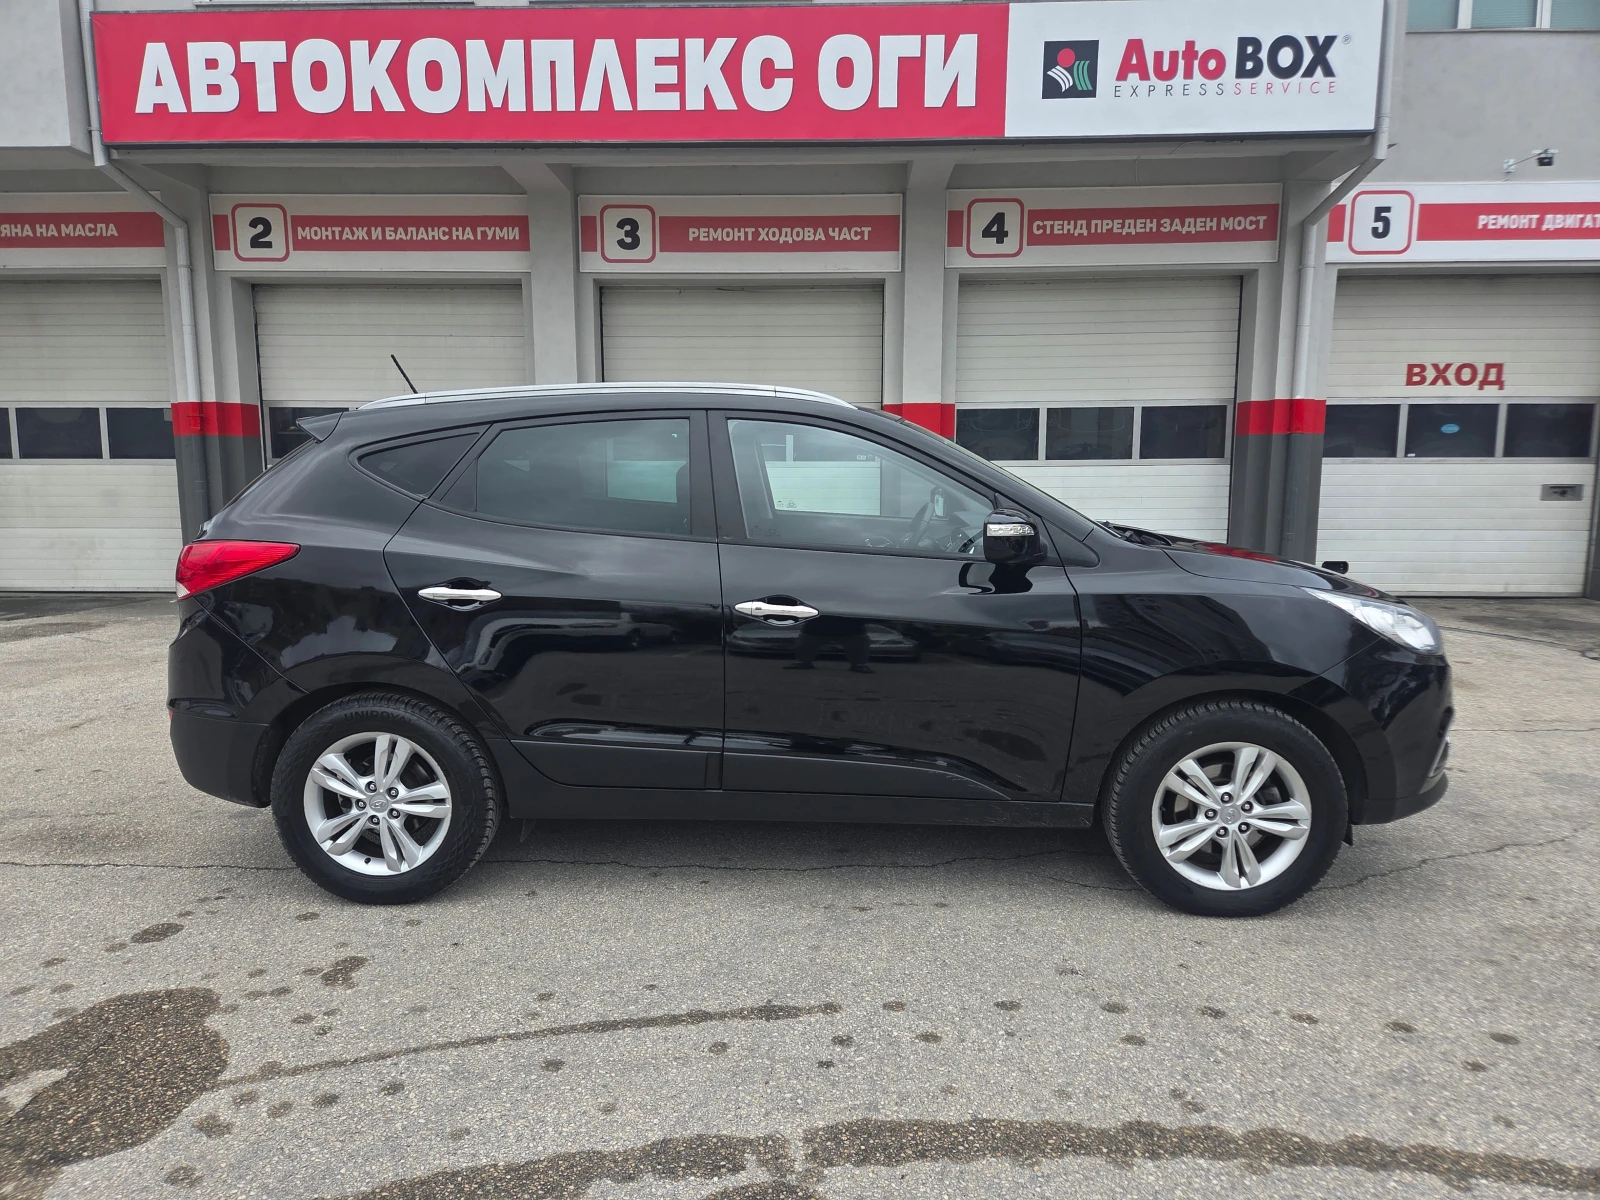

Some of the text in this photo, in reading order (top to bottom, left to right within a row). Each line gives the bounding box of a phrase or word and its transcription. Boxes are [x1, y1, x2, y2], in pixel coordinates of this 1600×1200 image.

[1115, 34, 1338, 81] Auto BOX
[136, 34, 978, 113] АВТОКОМПЛЕКС ОГИ
[1114, 81, 1337, 98] EXPRESS SERVICE
[0, 223, 119, 238] ЯНА НА МАСЛА
[248, 216, 273, 249] 2
[297, 226, 520, 241] МОНТАЖ И БАЛАНС НА ГУМИ
[615, 217, 641, 251] 3
[981, 211, 1009, 245] 4
[1032, 215, 1268, 237] СТЕНД ПРЕДЕН ЗАДЕН МОСТ
[1371, 206, 1392, 239] 5
[1477, 213, 1540, 230] РЕМОНТ
[688, 226, 872, 245] РЕМОНТ ХОДОВА ЧАСТ
[1405, 363, 1505, 390] ВХОД
